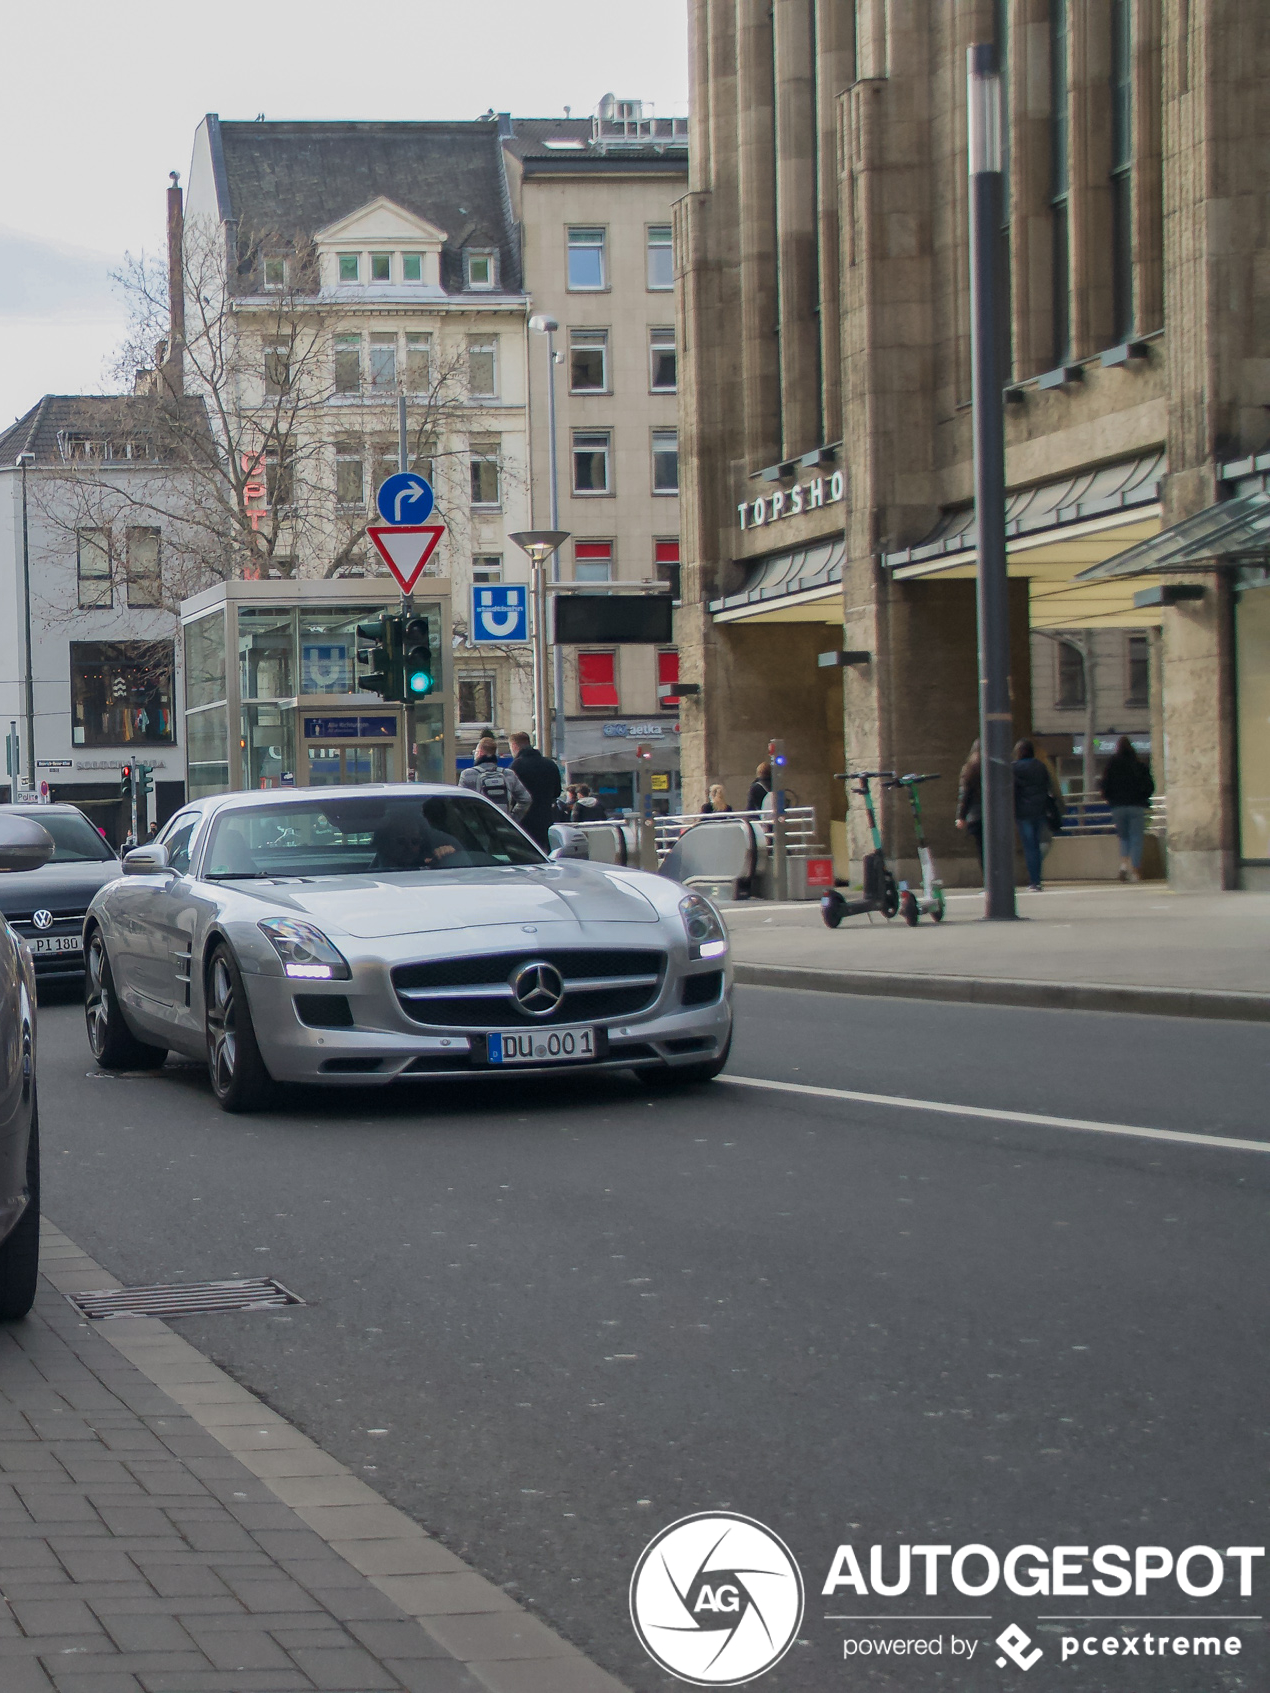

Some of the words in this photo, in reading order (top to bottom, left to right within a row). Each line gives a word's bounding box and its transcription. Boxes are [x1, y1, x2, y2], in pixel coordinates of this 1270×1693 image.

[737, 470, 844, 531] TOPSHO
[476, 605, 524, 613] stadtbahn
[36, 939, 52, 951] PI
[55, 938, 78, 950] 180
[502, 1035, 533, 1058] DU
